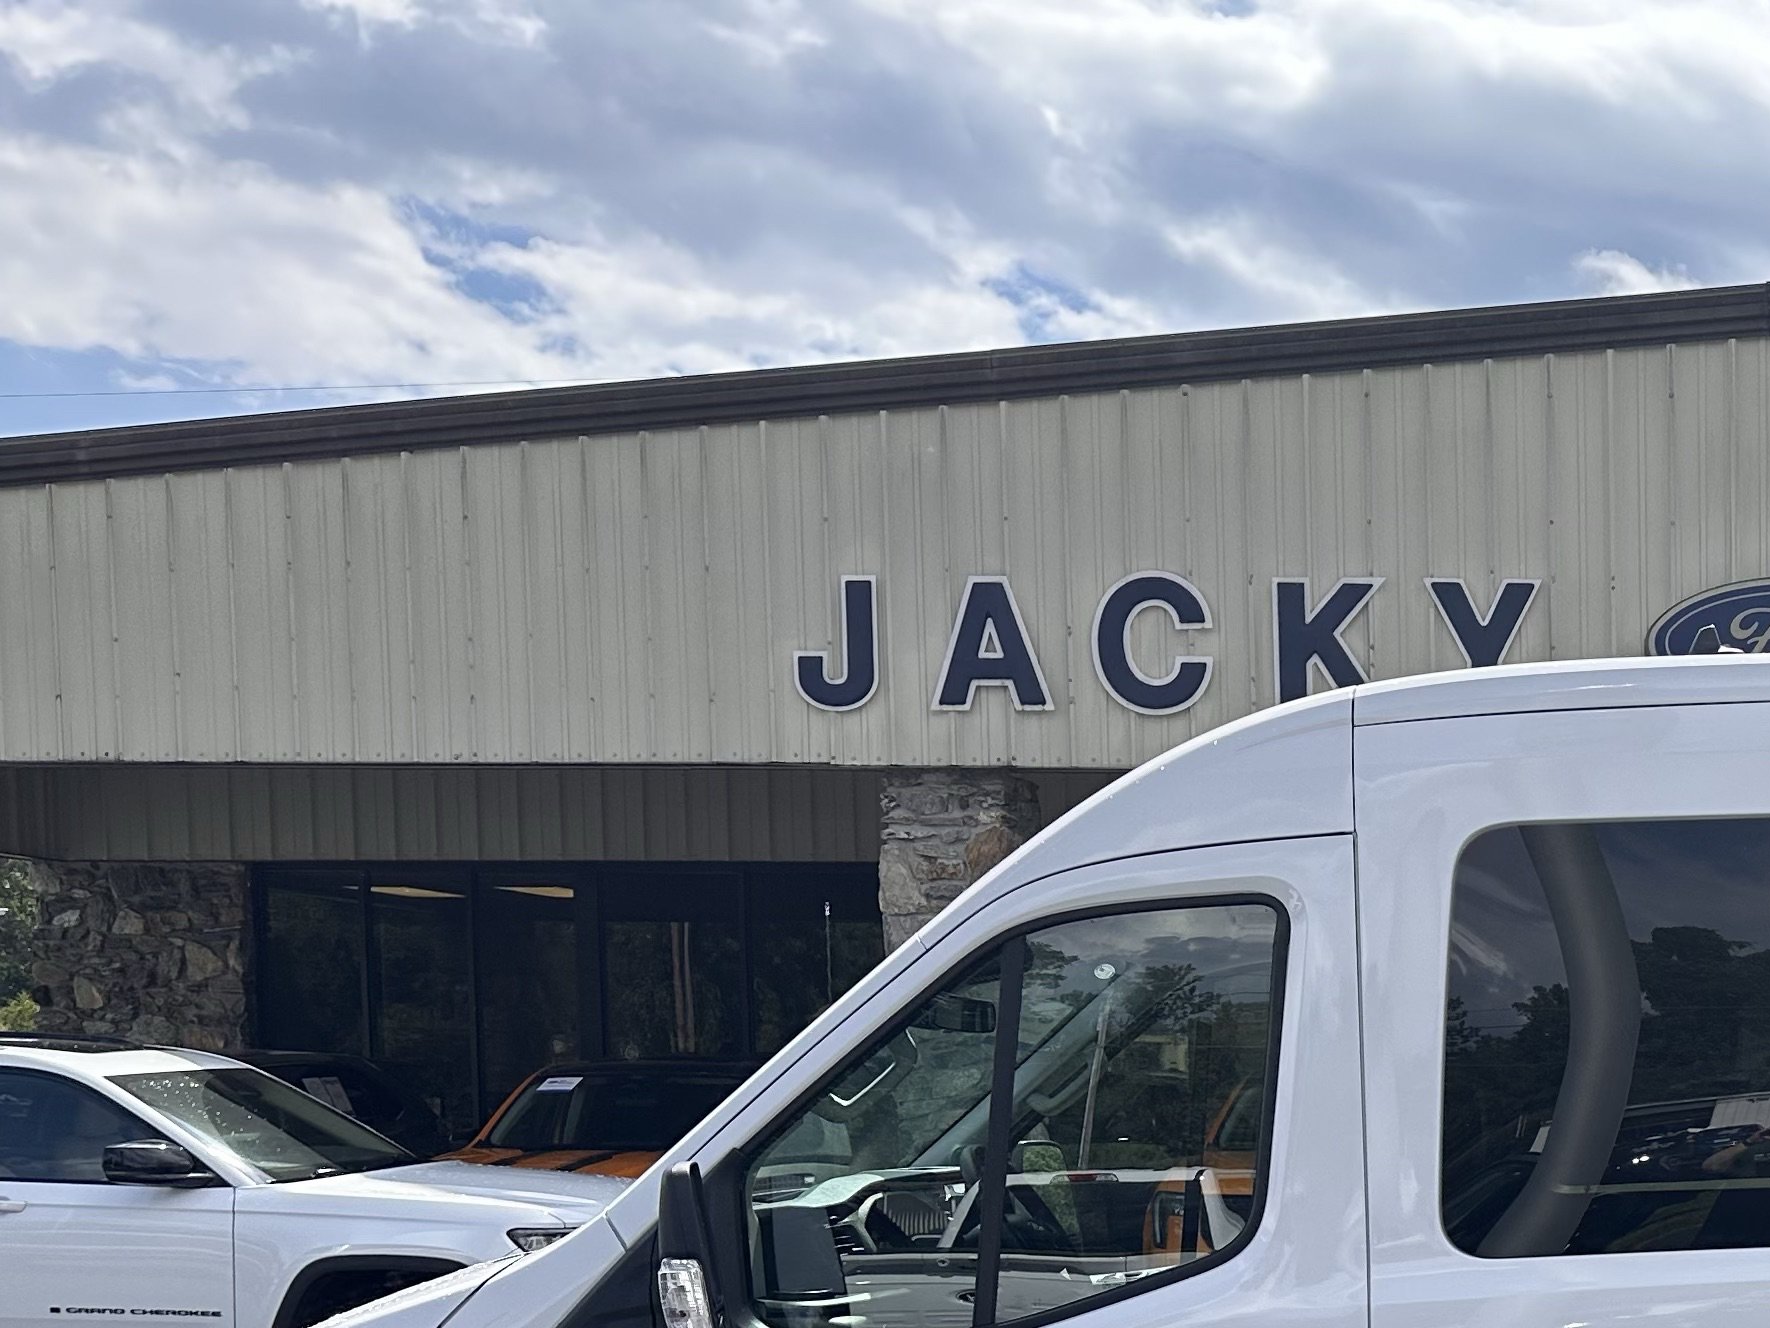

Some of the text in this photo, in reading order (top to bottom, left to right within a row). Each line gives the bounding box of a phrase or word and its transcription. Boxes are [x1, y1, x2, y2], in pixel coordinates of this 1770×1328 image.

[793, 570, 1542, 714] JACKY
[65, 1306, 222, 1318] GRAND CHEROKEE
